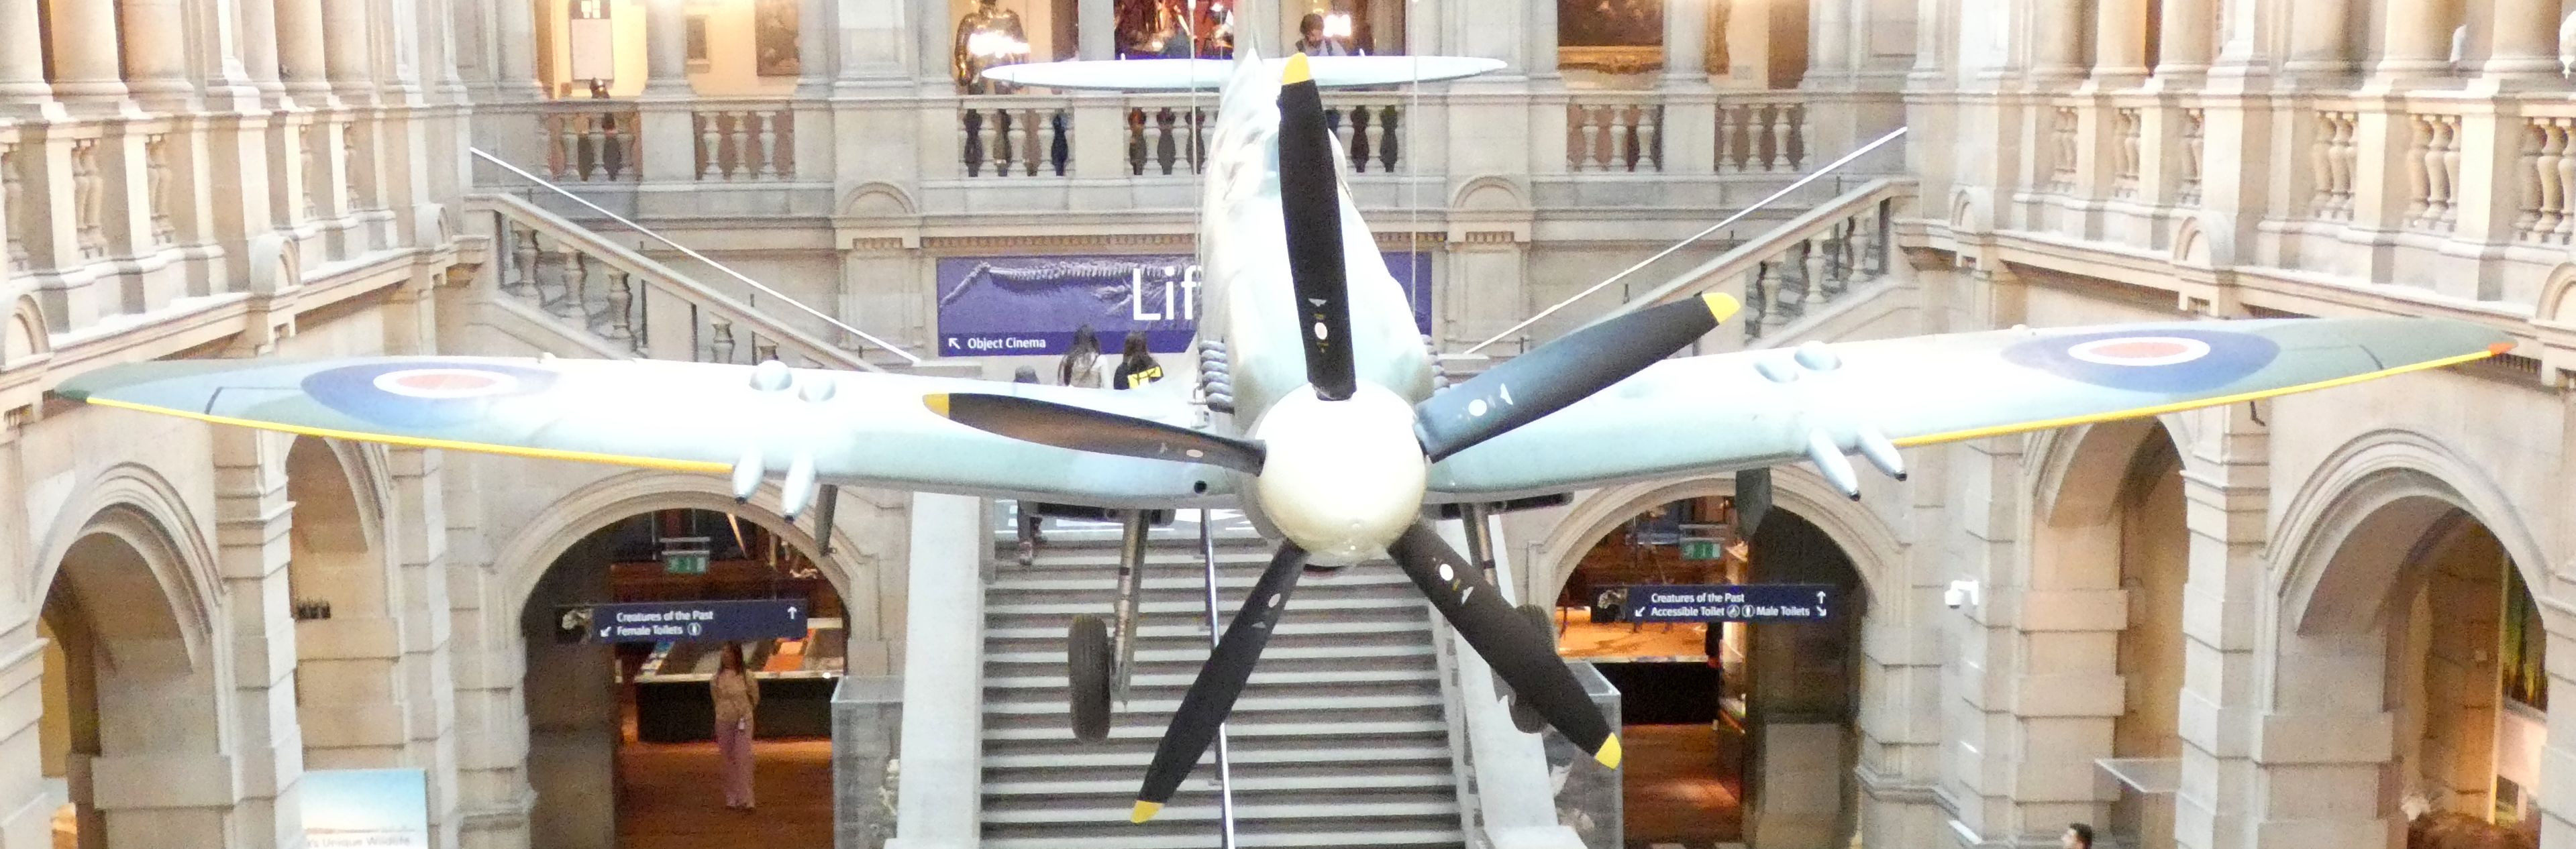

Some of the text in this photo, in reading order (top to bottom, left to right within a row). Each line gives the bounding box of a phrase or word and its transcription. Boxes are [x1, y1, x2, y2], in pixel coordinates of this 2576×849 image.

[1133, 265, 1202, 321] Lif
[968, 337, 1046, 351] Object Cinema
[1651, 593, 1745, 604] Creatures of the Past
[617, 610, 713, 622] Creatures of the Past
[1651, 606, 1724, 616] Accessible Toilet
[1756, 606, 1810, 616] Male Toilets
[617, 625, 683, 636] Female Toilets
